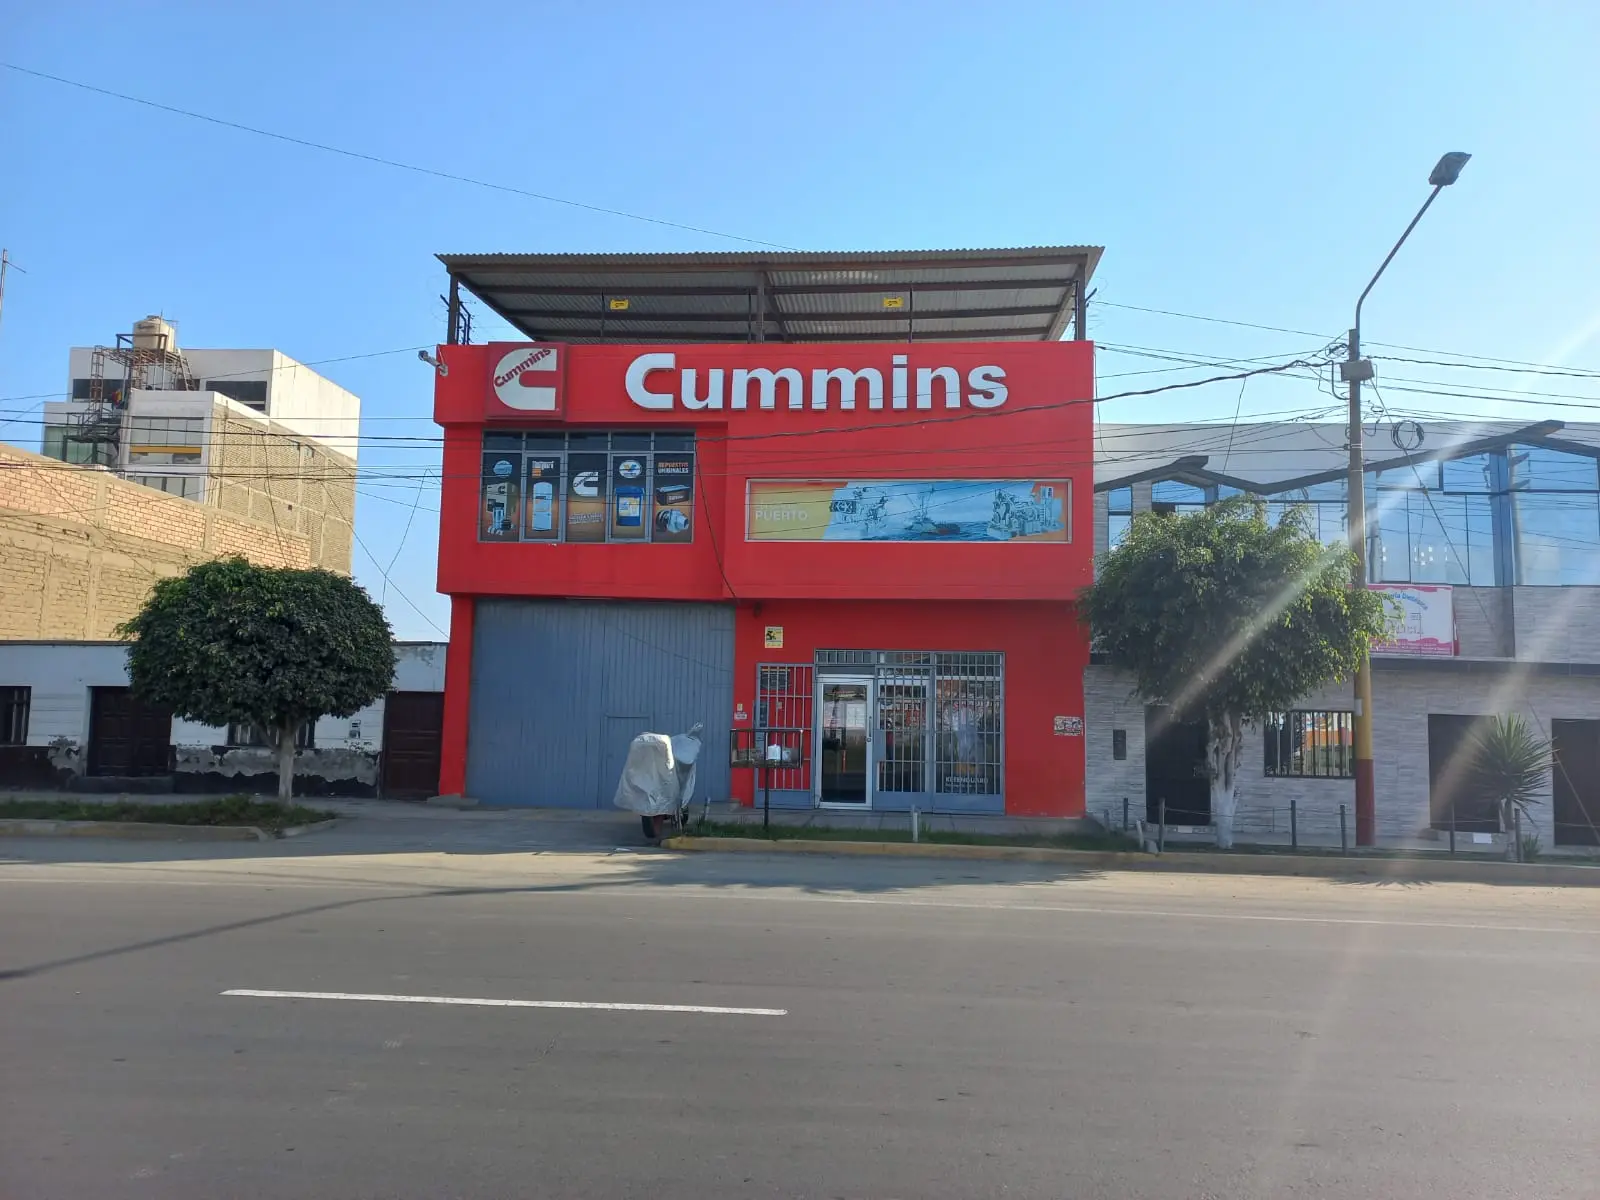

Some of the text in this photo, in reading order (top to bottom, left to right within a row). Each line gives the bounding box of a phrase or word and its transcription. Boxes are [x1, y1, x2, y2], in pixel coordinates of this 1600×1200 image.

[494, 348, 552, 387] Cummins
[625, 353, 1008, 409] Cummins
[755, 510, 808, 521] PUERTO
